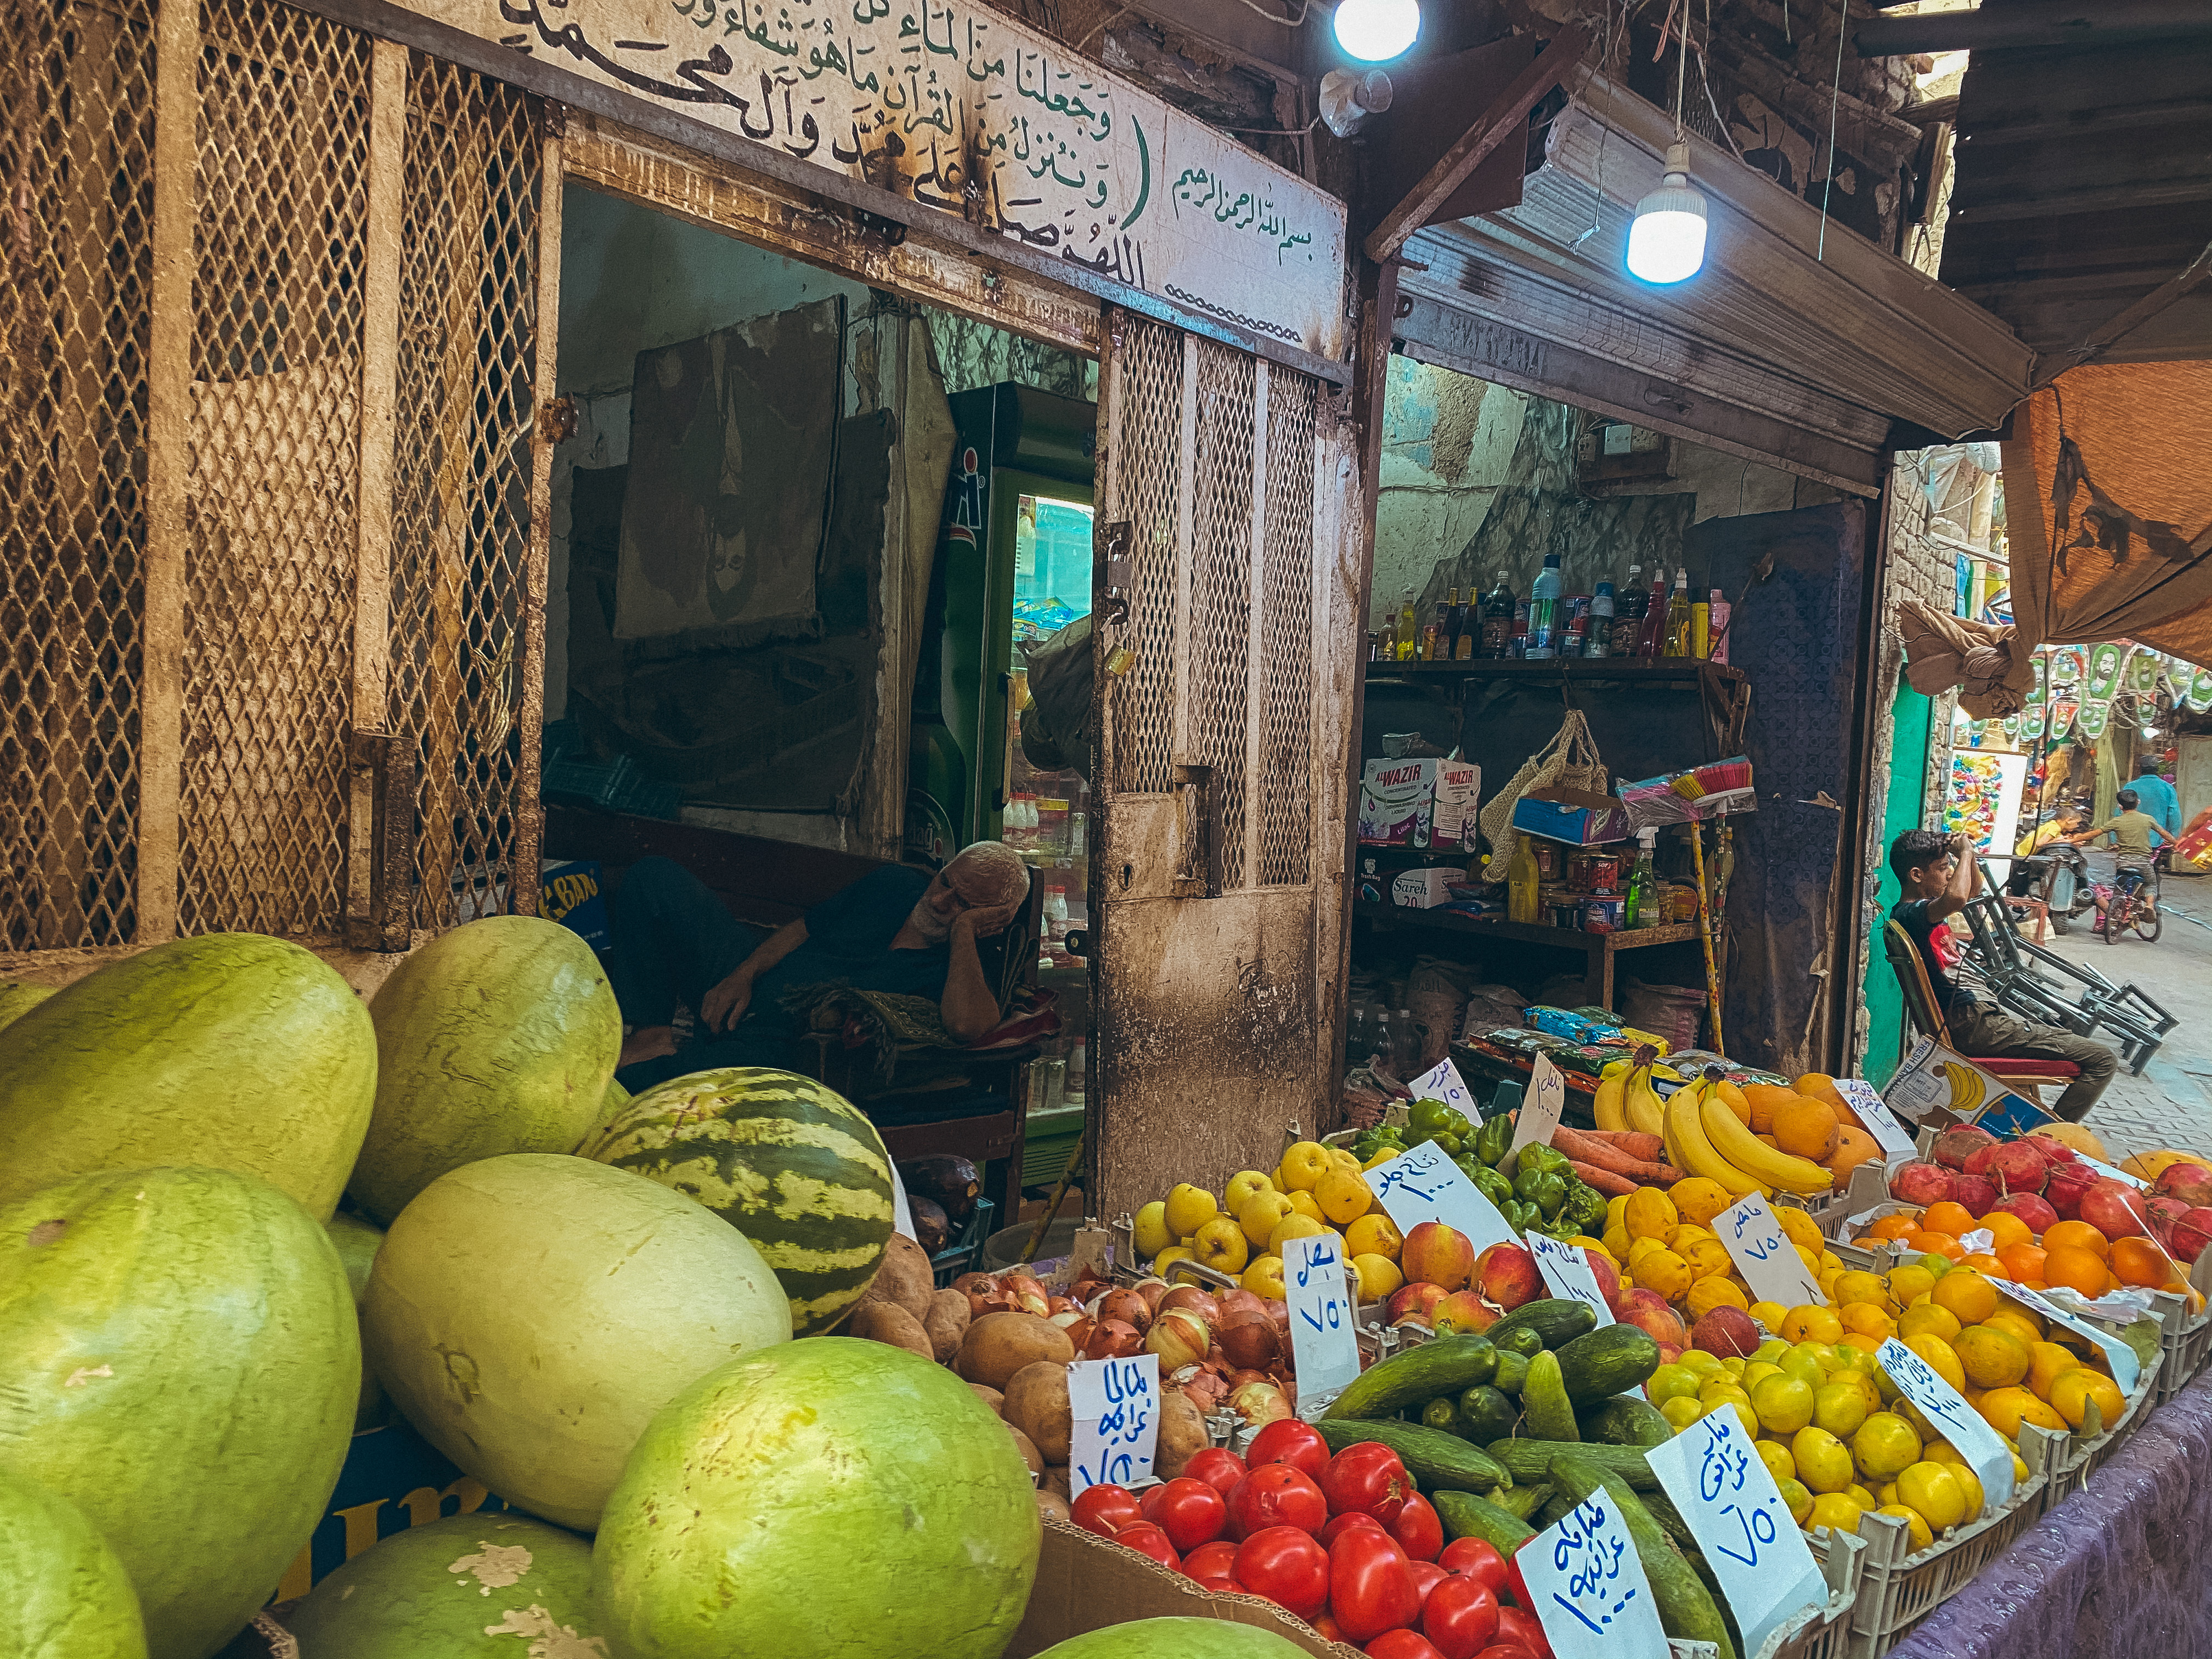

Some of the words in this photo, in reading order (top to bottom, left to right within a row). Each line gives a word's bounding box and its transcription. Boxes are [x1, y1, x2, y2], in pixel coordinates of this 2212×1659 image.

[1278, 233, 1313, 267] بسم
[1397, 822, 1411, 834] Lilac
[1393, 879, 1428, 895] Sareh
[1909, 1040, 1931, 1064] FRESH
[1297, 1242, 1335, 1288] بصل
[1299, 1295, 1348, 1333] ٧٥٠
[1553, 1588, 1636, 1635] ١٠٠٠
